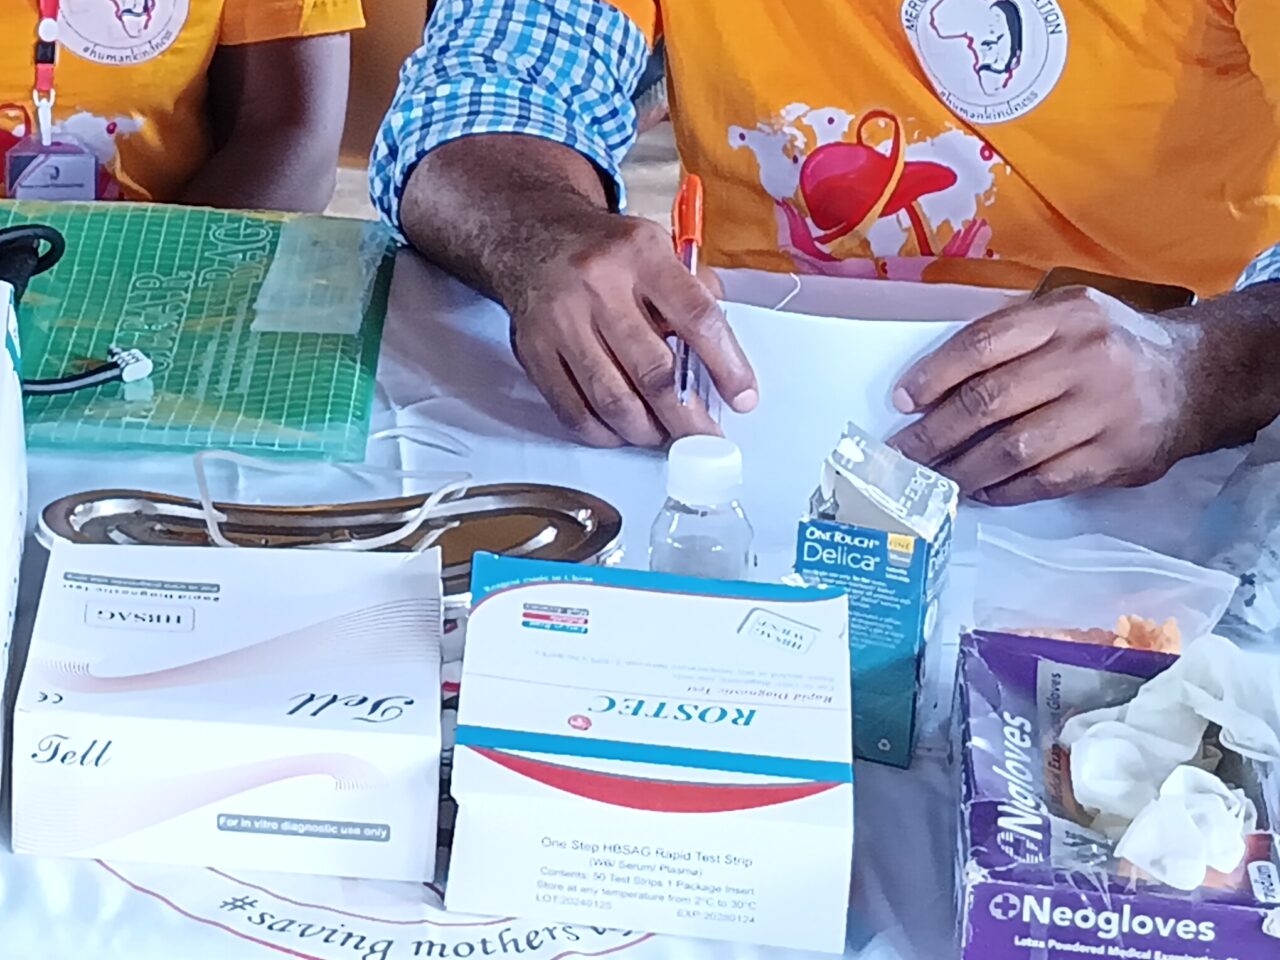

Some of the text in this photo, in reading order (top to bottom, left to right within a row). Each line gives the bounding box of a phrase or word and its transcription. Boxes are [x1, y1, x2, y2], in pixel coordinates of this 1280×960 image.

[286, 692, 414, 723] Tell
[587, 695, 757, 727] ROSTEC
[31, 734, 113, 767] Tell
[219, 816, 239, 826] For
[253, 818, 279, 830] vitro
[281, 820, 338, 834] diagnostic
[340, 826, 361, 835] use
[363, 826, 388, 839] only
[541, 836, 753, 868] One Step HBSAG Rapid Test Strip
[601, 887, 665, 902] temperature
[610, 872, 630, 884] Test
[676, 880, 722, 894] Package
[725, 885, 755, 896] Insert
[219, 894, 582, 960] #saving mothers
[1022, 894, 1216, 942] Neogloves
[1048, 938, 1105, 956] Powdered
[1108, 945, 1152, 960] Medical
